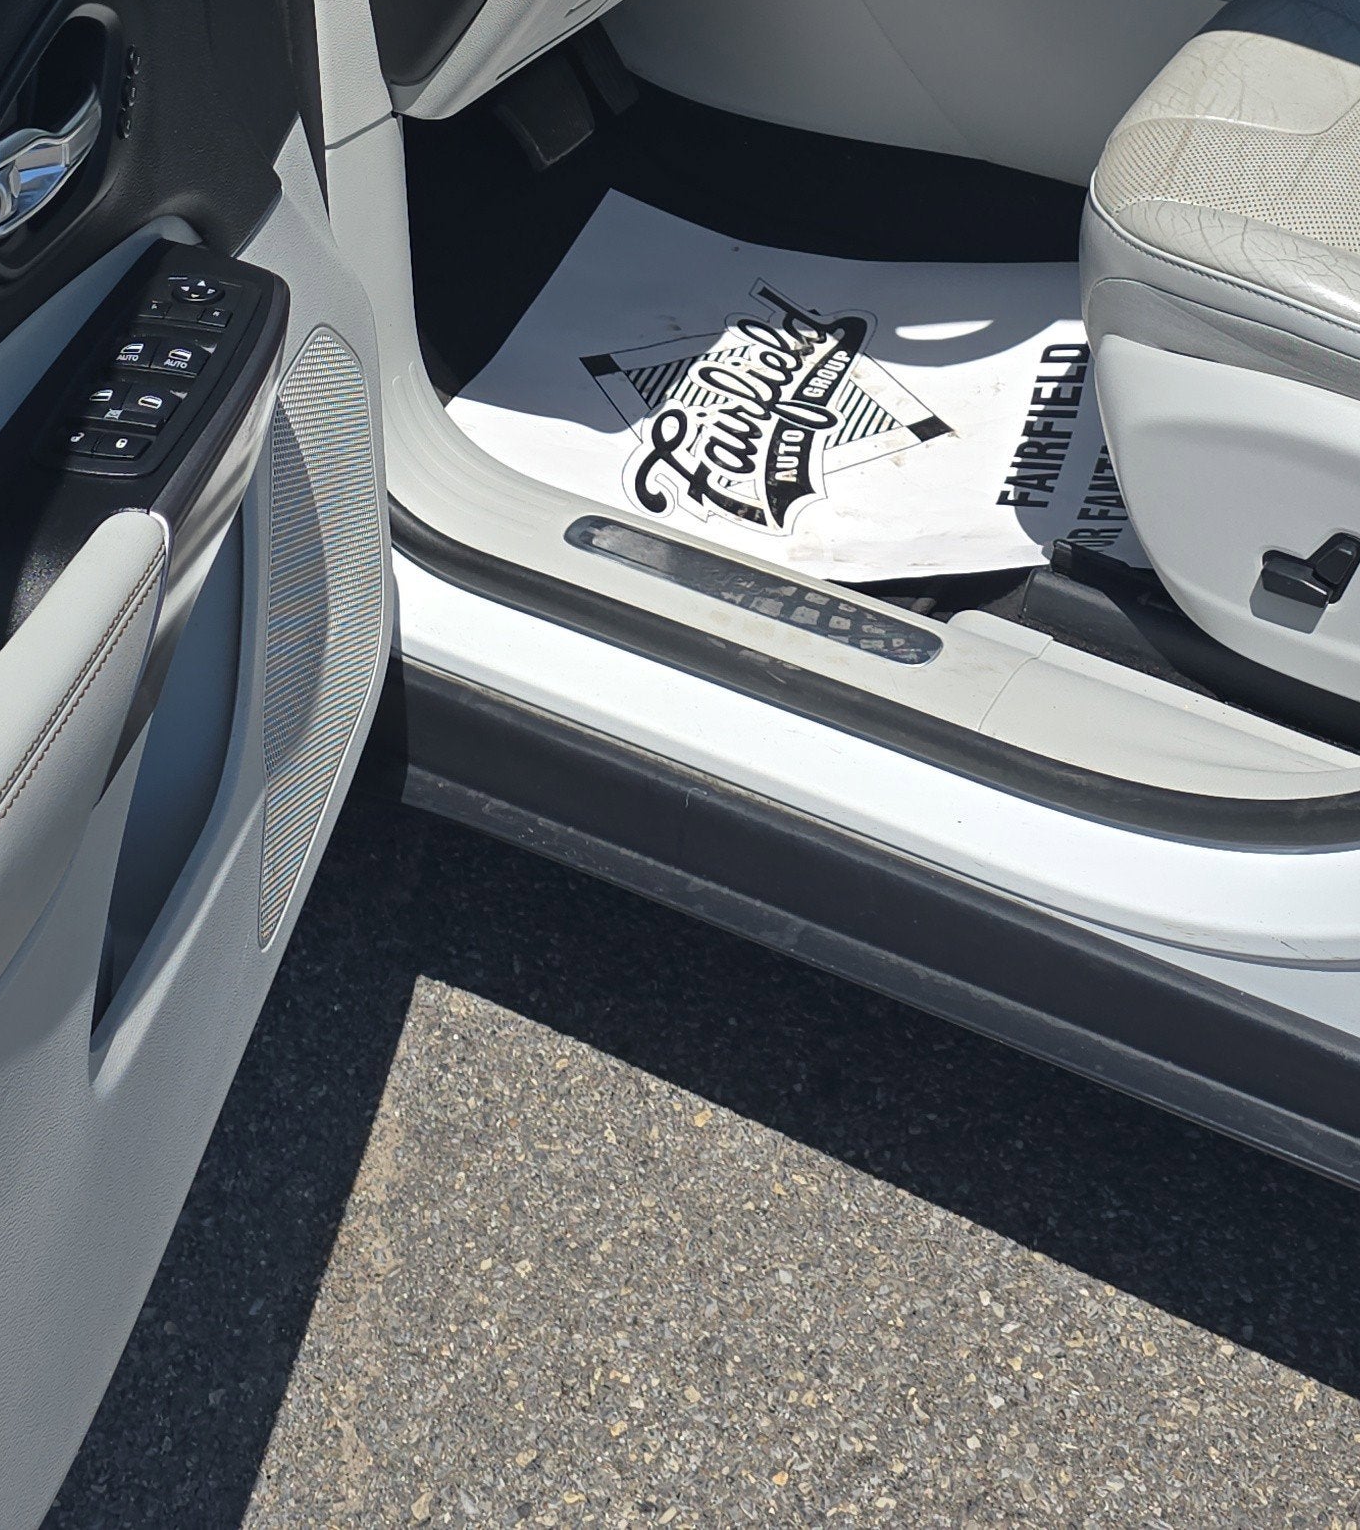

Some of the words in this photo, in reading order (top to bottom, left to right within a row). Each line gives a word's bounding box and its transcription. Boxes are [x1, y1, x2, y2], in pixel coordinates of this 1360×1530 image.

[116, 352, 139, 362] AUTO
[163, 358, 188, 370] AUTO
[634, 287, 838, 516] Fairfield
[774, 429, 805, 483] AUTO
[802, 350, 852, 399] GROUP
[995, 342, 1090, 508] FAIRFIELD
